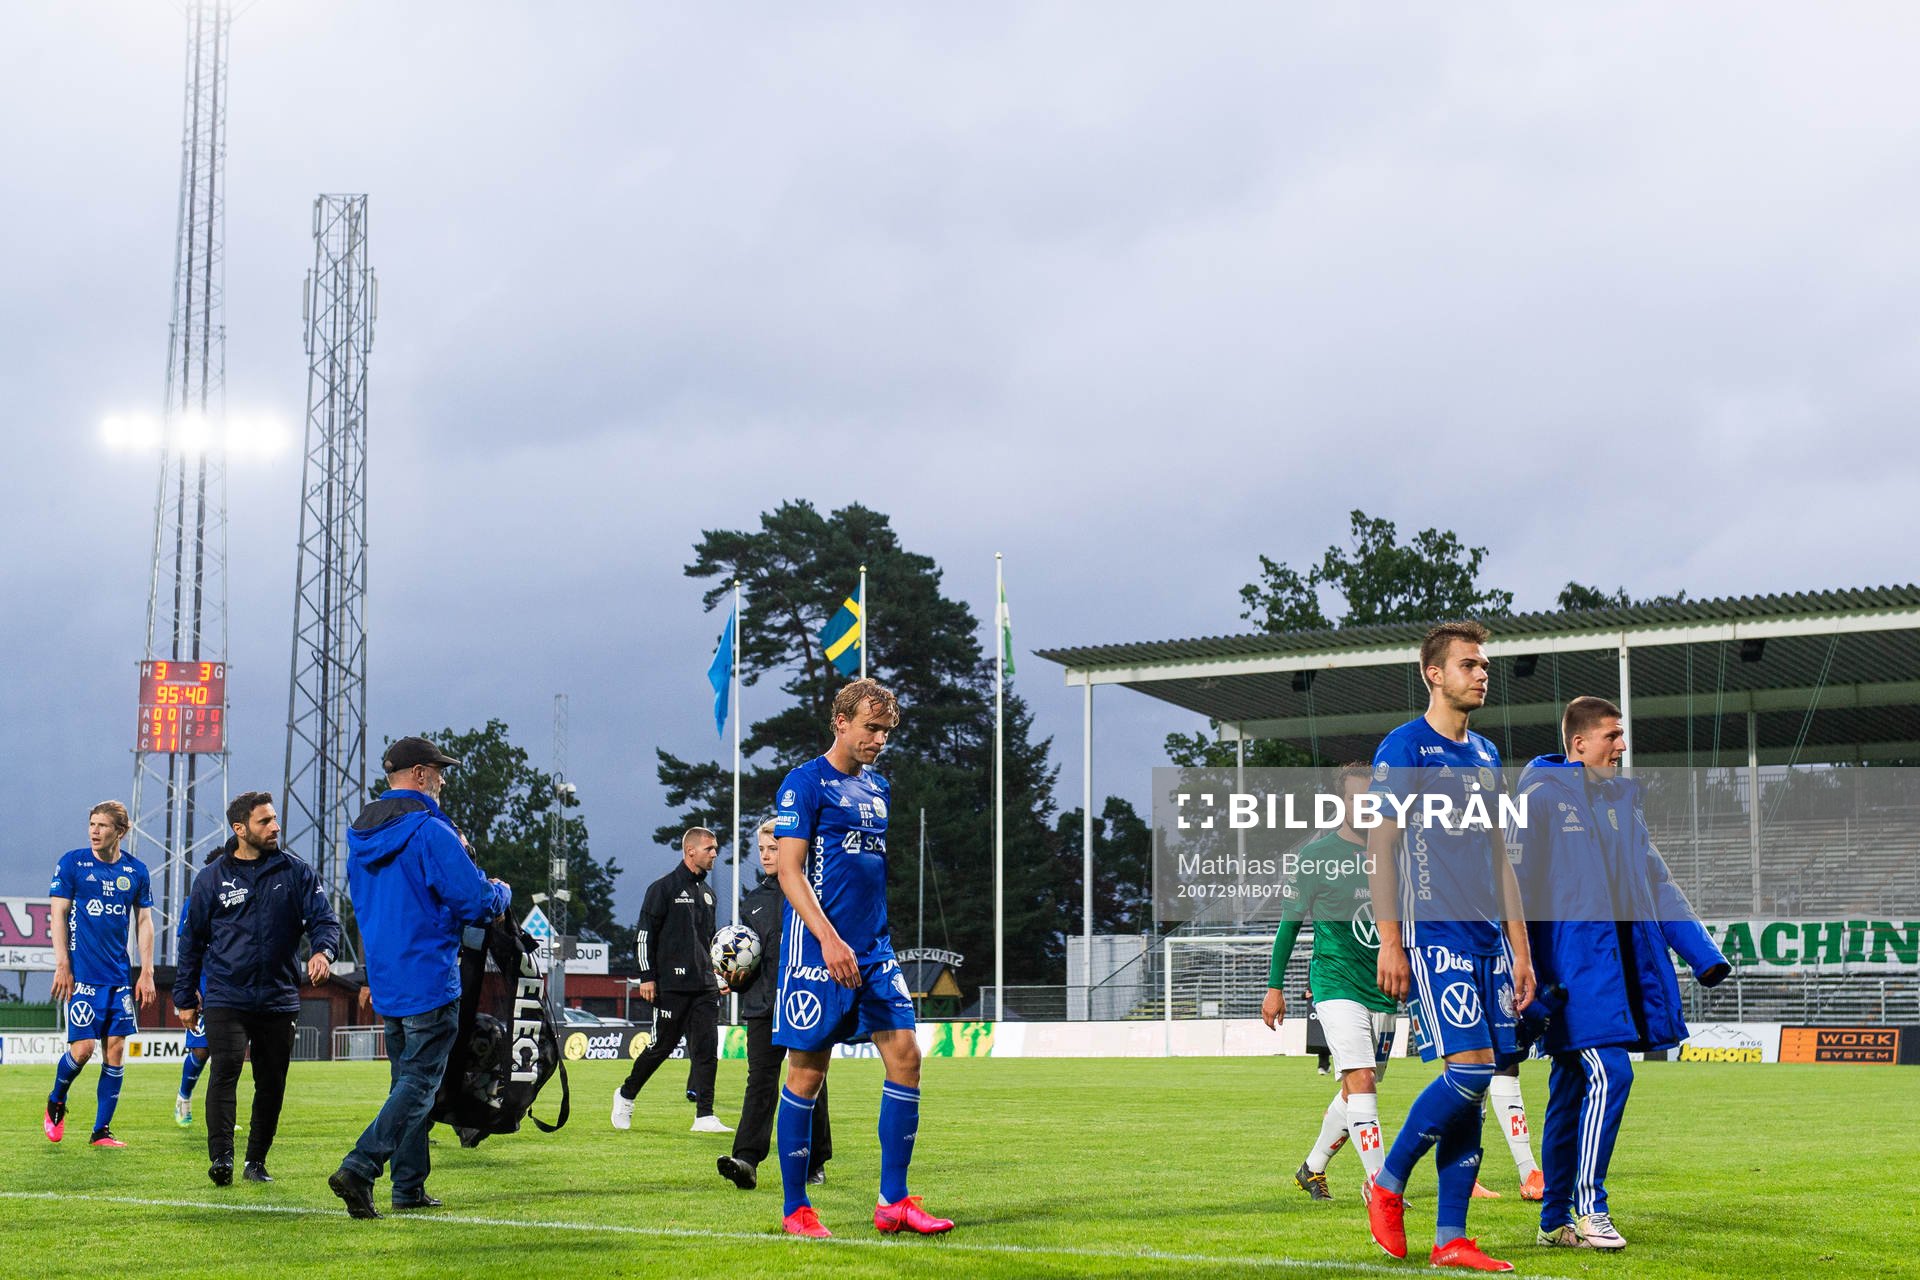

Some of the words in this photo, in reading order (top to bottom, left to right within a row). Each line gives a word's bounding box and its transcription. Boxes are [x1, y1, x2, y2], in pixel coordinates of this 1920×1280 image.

[142, 664, 152, 677] H
[155, 662, 167, 680] 3
[199, 663, 211, 681] 3
[214, 665, 224, 679] G
[157, 686, 208, 705] 95:40
[185, 709, 193, 720] D
[1678, 919, 1920, 967] ACHIN
[511, 952, 545, 1085] SELECT
[660, 1010, 672, 1018] TN
[8, 1037, 45, 1054] TMG
[1820, 1034, 1892, 1045] WORK
[1678, 1043, 1763, 1063] Jonsons
[1820, 1052, 1890, 1060] SYSTEM
